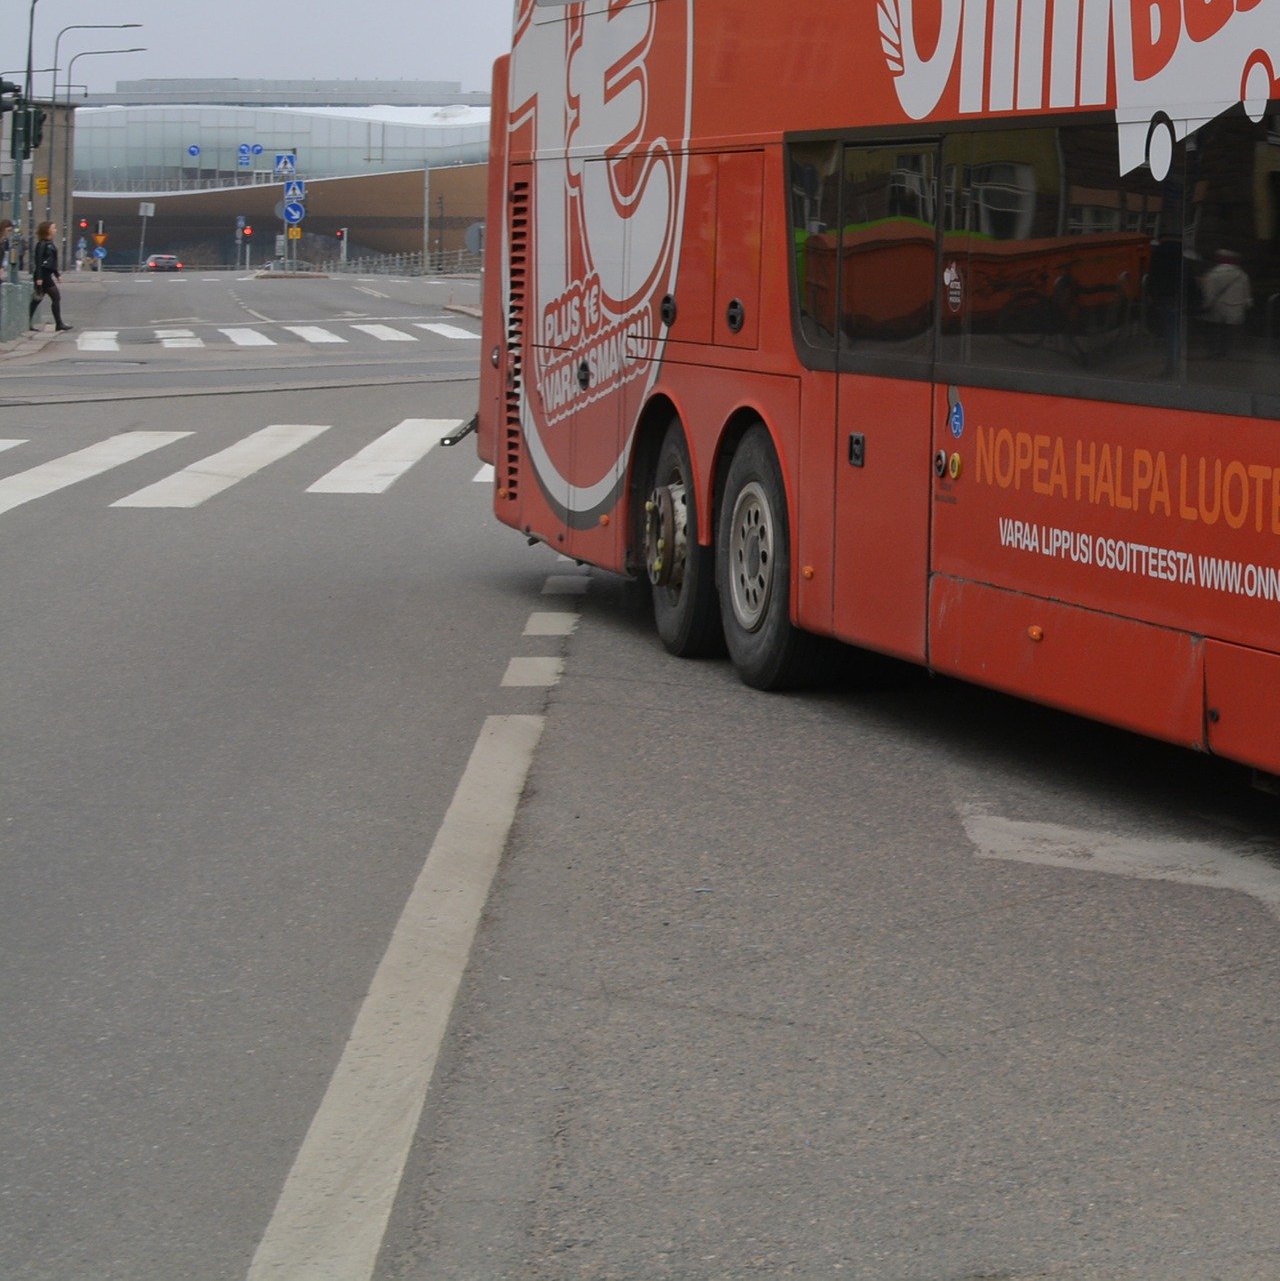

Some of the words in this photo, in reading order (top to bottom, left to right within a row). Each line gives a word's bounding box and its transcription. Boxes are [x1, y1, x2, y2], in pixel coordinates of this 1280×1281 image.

[544, 296, 580, 352] PLUS
[583, 284, 599, 329] 1€
[975, 425, 1068, 498] NOPEA
[1075, 439, 1171, 517] HALPA
[999, 517, 1040, 554] VARAA
[1042, 527, 1093, 565] LIPPUSI
[1095, 536, 1196, 587] OSOITTEESTA
